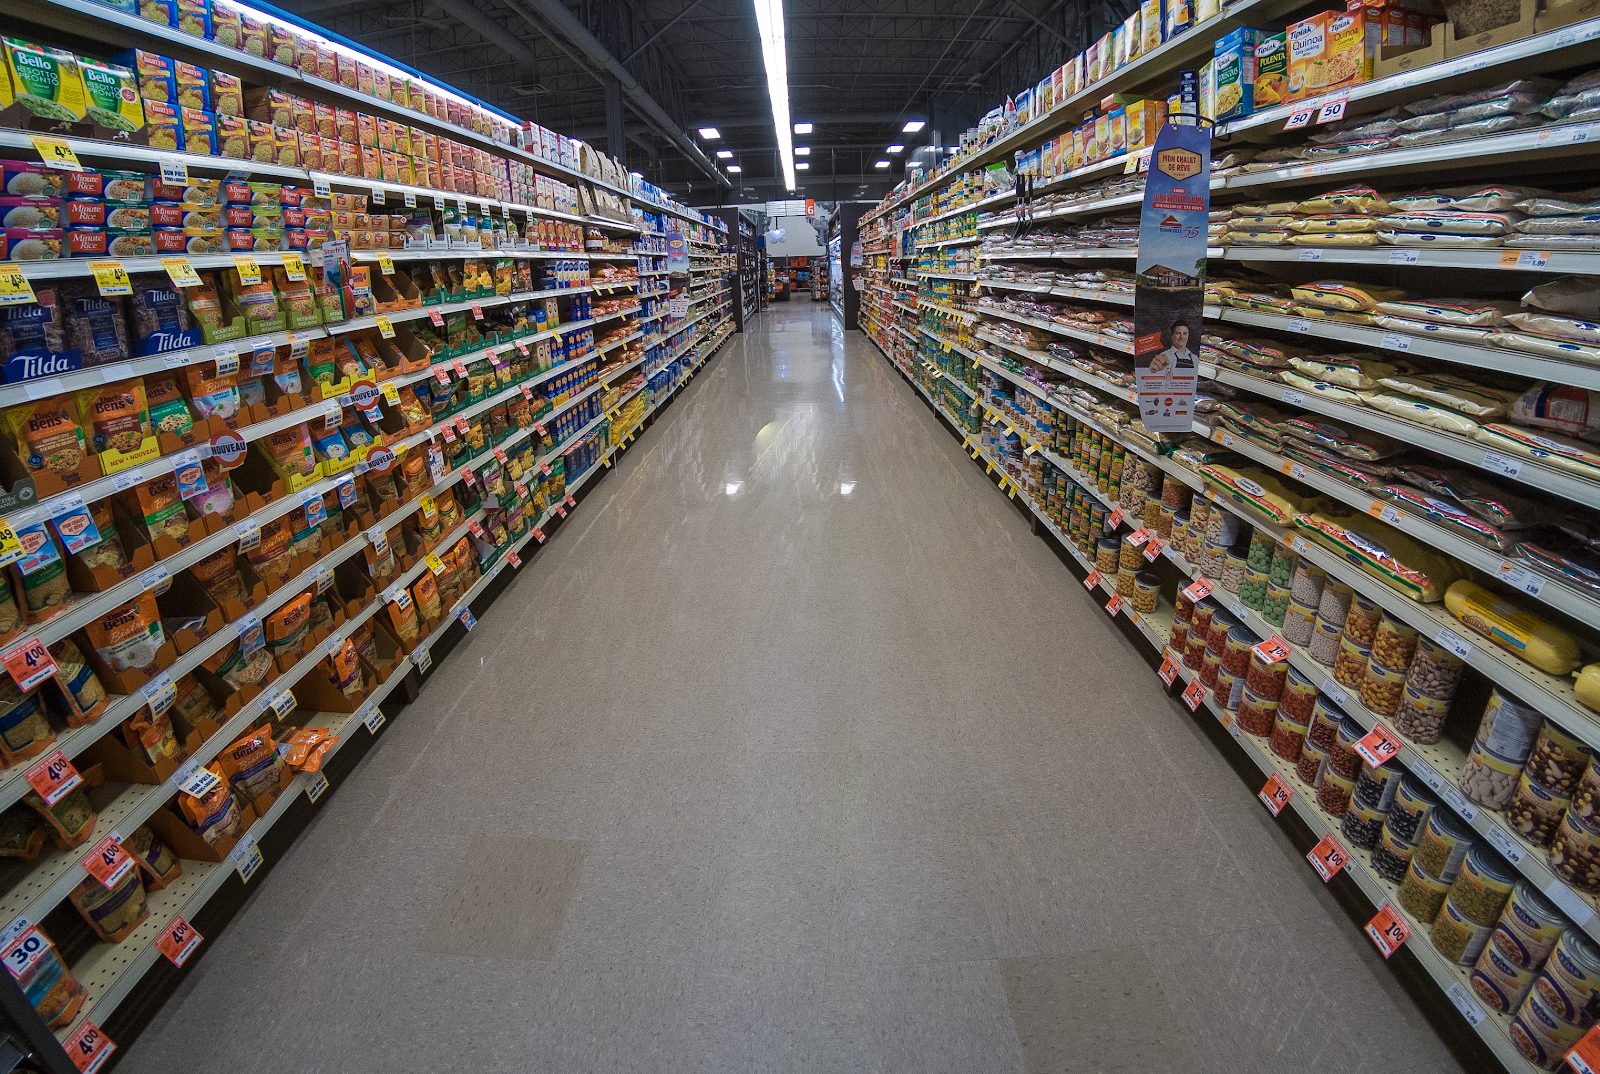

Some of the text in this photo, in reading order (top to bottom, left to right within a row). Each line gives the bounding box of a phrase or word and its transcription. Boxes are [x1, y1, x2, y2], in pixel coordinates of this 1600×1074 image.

[1331, 18, 1351, 32] Tipiak
[1290, 26, 1312, 39] Tipiak
[1334, 27, 1358, 41] Quinoa
[1293, 35, 1322, 51] Quinoa
[19, 51, 51, 70] Bello
[1260, 52, 1286, 66] POLENTA
[17, 65, 58, 81] RISOTTO
[18, 72, 59, 86] PRONTO
[88, 68, 116, 85] Bello
[87, 81, 120, 94] RISOTTO
[1324, 103, 1342, 117] 50
[1291, 112, 1308, 125] 50
[1162, 154, 1197, 164] MON CHALET
[70, 173, 99, 184] Minute
[77, 182, 95, 191] Rice
[72, 204, 101, 213] Minute
[154, 207, 180, 215] Minute
[807, 205, 814, 215] 6
[79, 212, 96, 220] Rice
[160, 214, 175, 222] Rice
[73, 233, 103, 242] Minute
[158, 233, 183, 241] Minute
[164, 240, 179, 248] Rice
[80, 241, 98, 249] Rice
[147, 289, 176, 302] Tilda
[77, 298, 110, 311] Tilda
[7, 306, 42, 321] Tilda
[151, 332, 192, 352] Tilda
[12, 353, 69, 379] Tilda
[350, 388, 380, 403] NOUVEAU
[211, 441, 246, 456] NOUVEAU
[110, 447, 157, 467] NEW NOUVEAU
[368, 452, 395, 468] NOUVEAU
[188, 773, 212, 793] BON PRIX
[11, 937, 40, 965] 30
